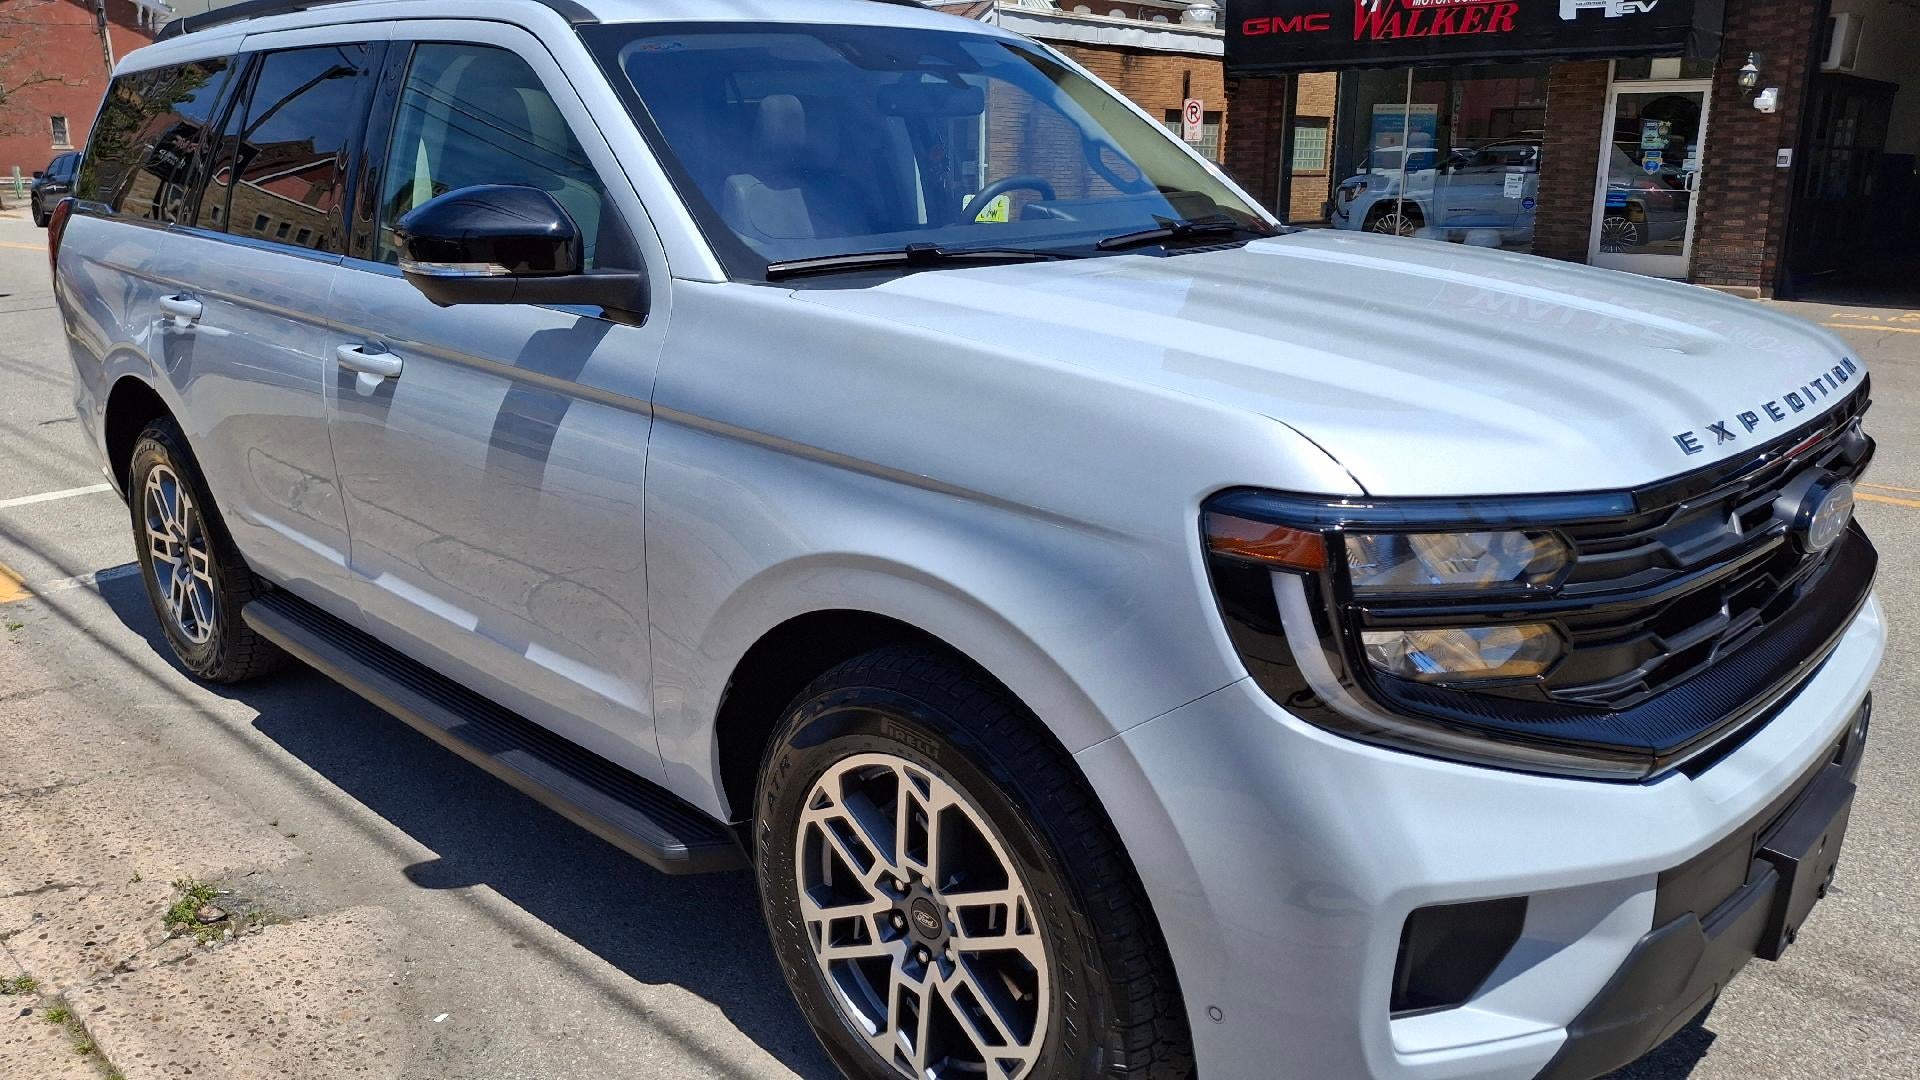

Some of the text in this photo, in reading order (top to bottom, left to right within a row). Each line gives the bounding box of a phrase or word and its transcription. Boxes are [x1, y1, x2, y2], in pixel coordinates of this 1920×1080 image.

[1241, 12, 1331, 36] GMC
[1353, 0, 1517, 41] WALKER
[1673, 356, 1857, 456] EXPEDITION
[880, 715, 941, 761] PIRELLI
[916, 911, 936, 927] Ford
